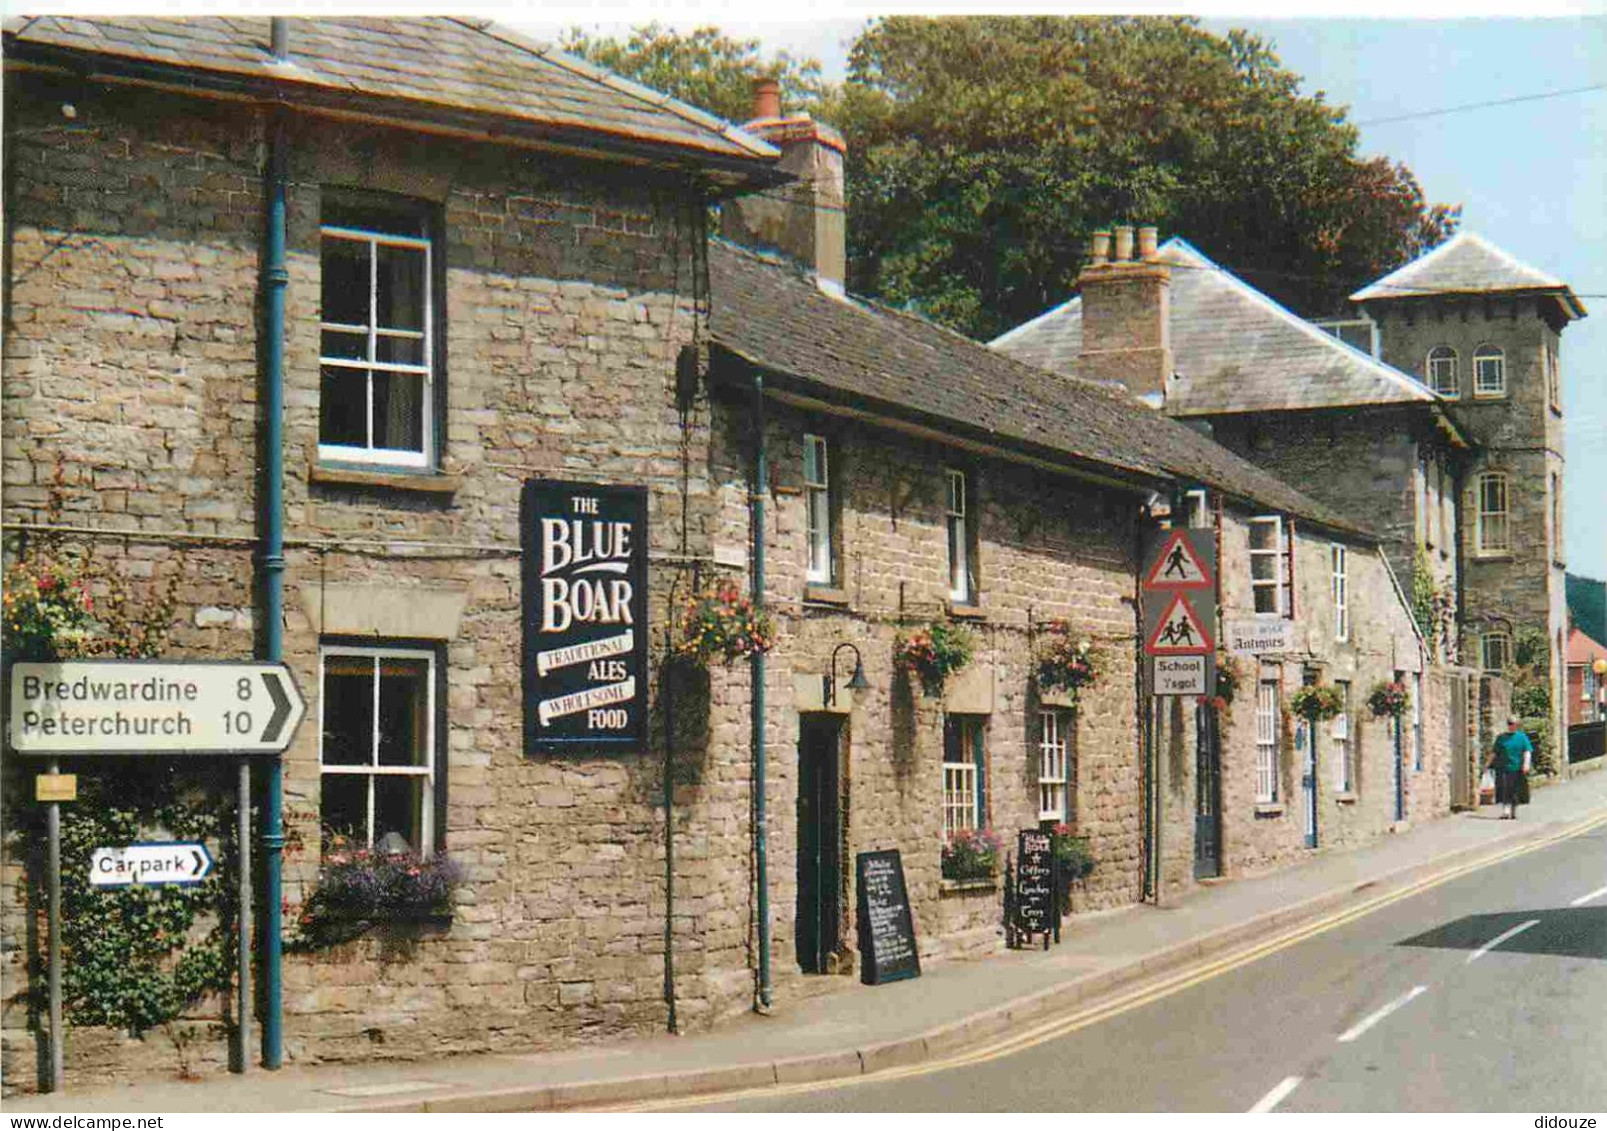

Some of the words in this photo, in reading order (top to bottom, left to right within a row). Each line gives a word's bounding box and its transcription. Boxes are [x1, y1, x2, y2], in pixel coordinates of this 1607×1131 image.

[572, 497, 599, 514] THE
[540, 517, 632, 577] BLUE
[540, 578, 634, 633] BOAR
[546, 638, 623, 665] TRADITIONAL
[1233, 638, 1284, 650] Antiques
[588, 661, 627, 680] ALES
[1157, 661, 1200, 672] School
[23, 676, 198, 701] Bredwardine
[236, 677, 252, 701] 8
[549, 685, 624, 713] WHOLESOME
[23, 711, 192, 735] Peterchurch
[223, 711, 252, 734] 10
[588, 710, 628, 729] FOOD
[99, 856, 136, 873] Car
[140, 855, 185, 876] park
